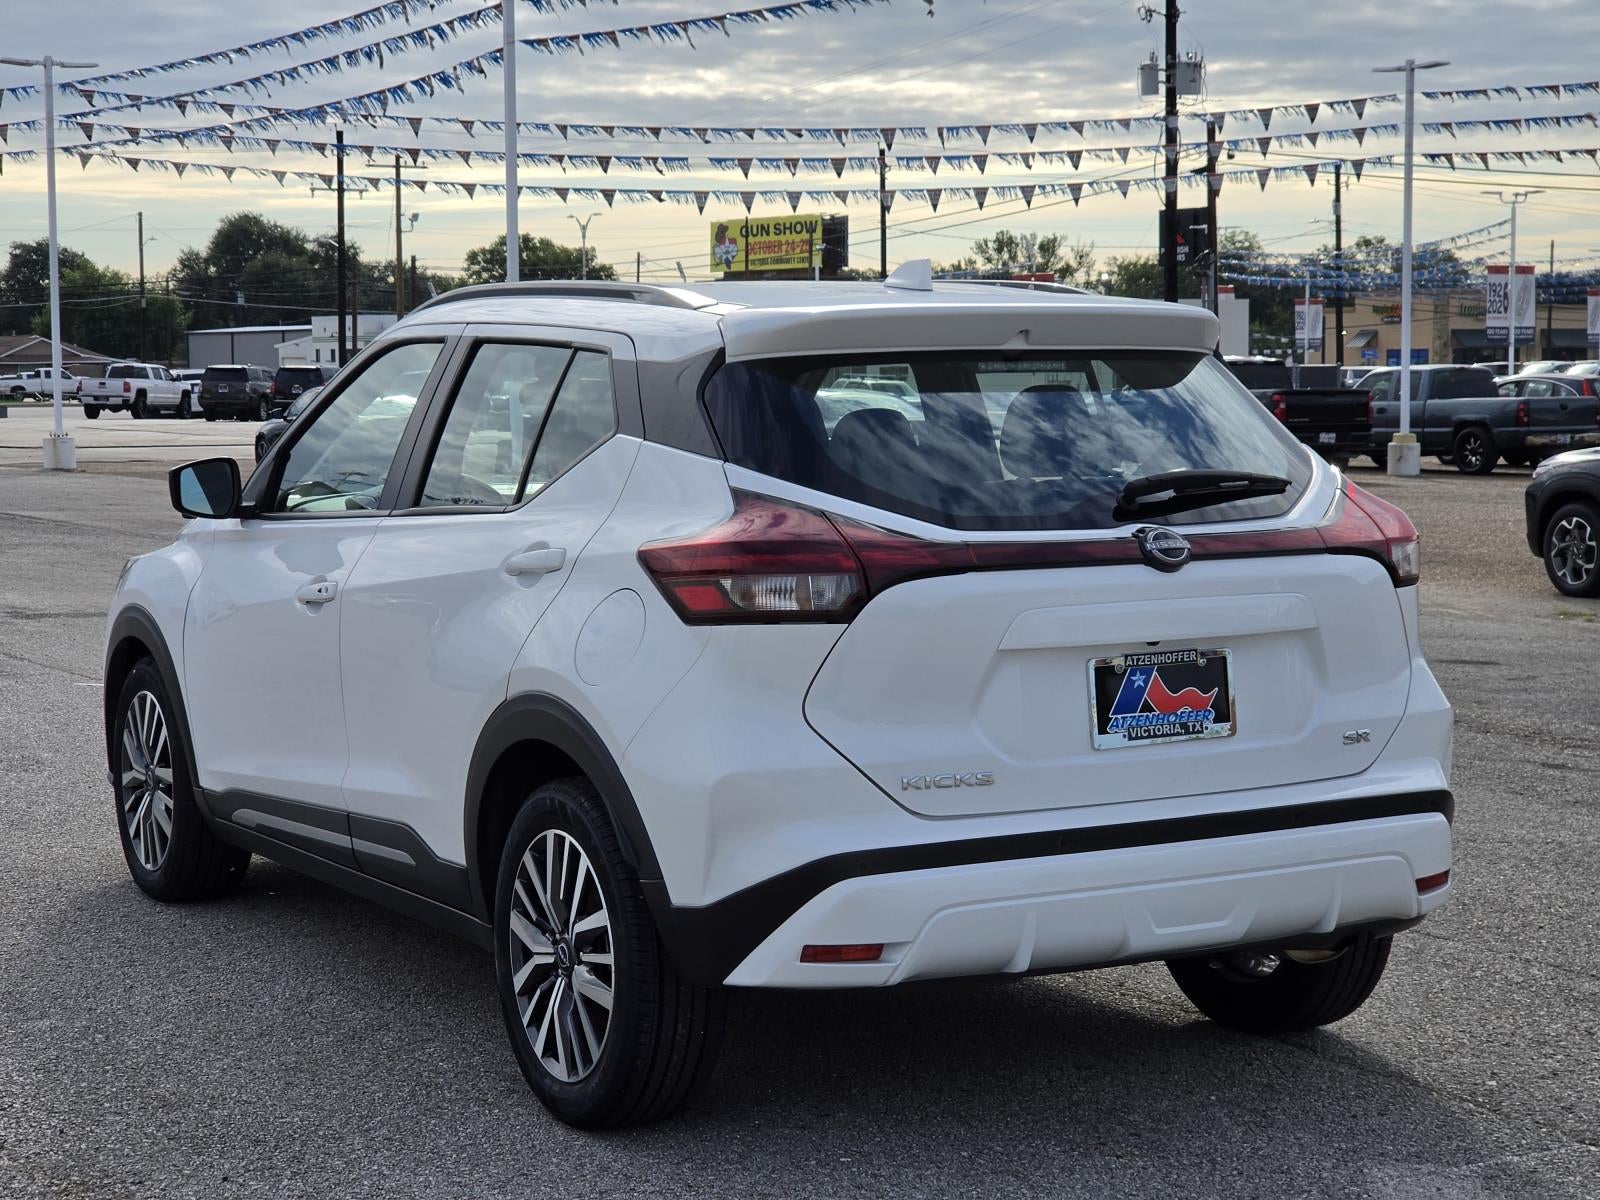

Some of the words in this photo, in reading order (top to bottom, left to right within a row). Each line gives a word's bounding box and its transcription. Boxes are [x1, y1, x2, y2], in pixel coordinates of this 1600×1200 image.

[740, 223, 770, 238] GUN
[773, 220, 818, 235] SHOW
[1125, 651, 1197, 666] ATZENHOFFER
[1109, 709, 1214, 730] ATZENHOFFER
[1129, 723, 1185, 738] VICTORIA,
[1188, 721, 1202, 732] TX
[1343, 729, 1370, 745] SR
[901, 771, 994, 791] KICKS
